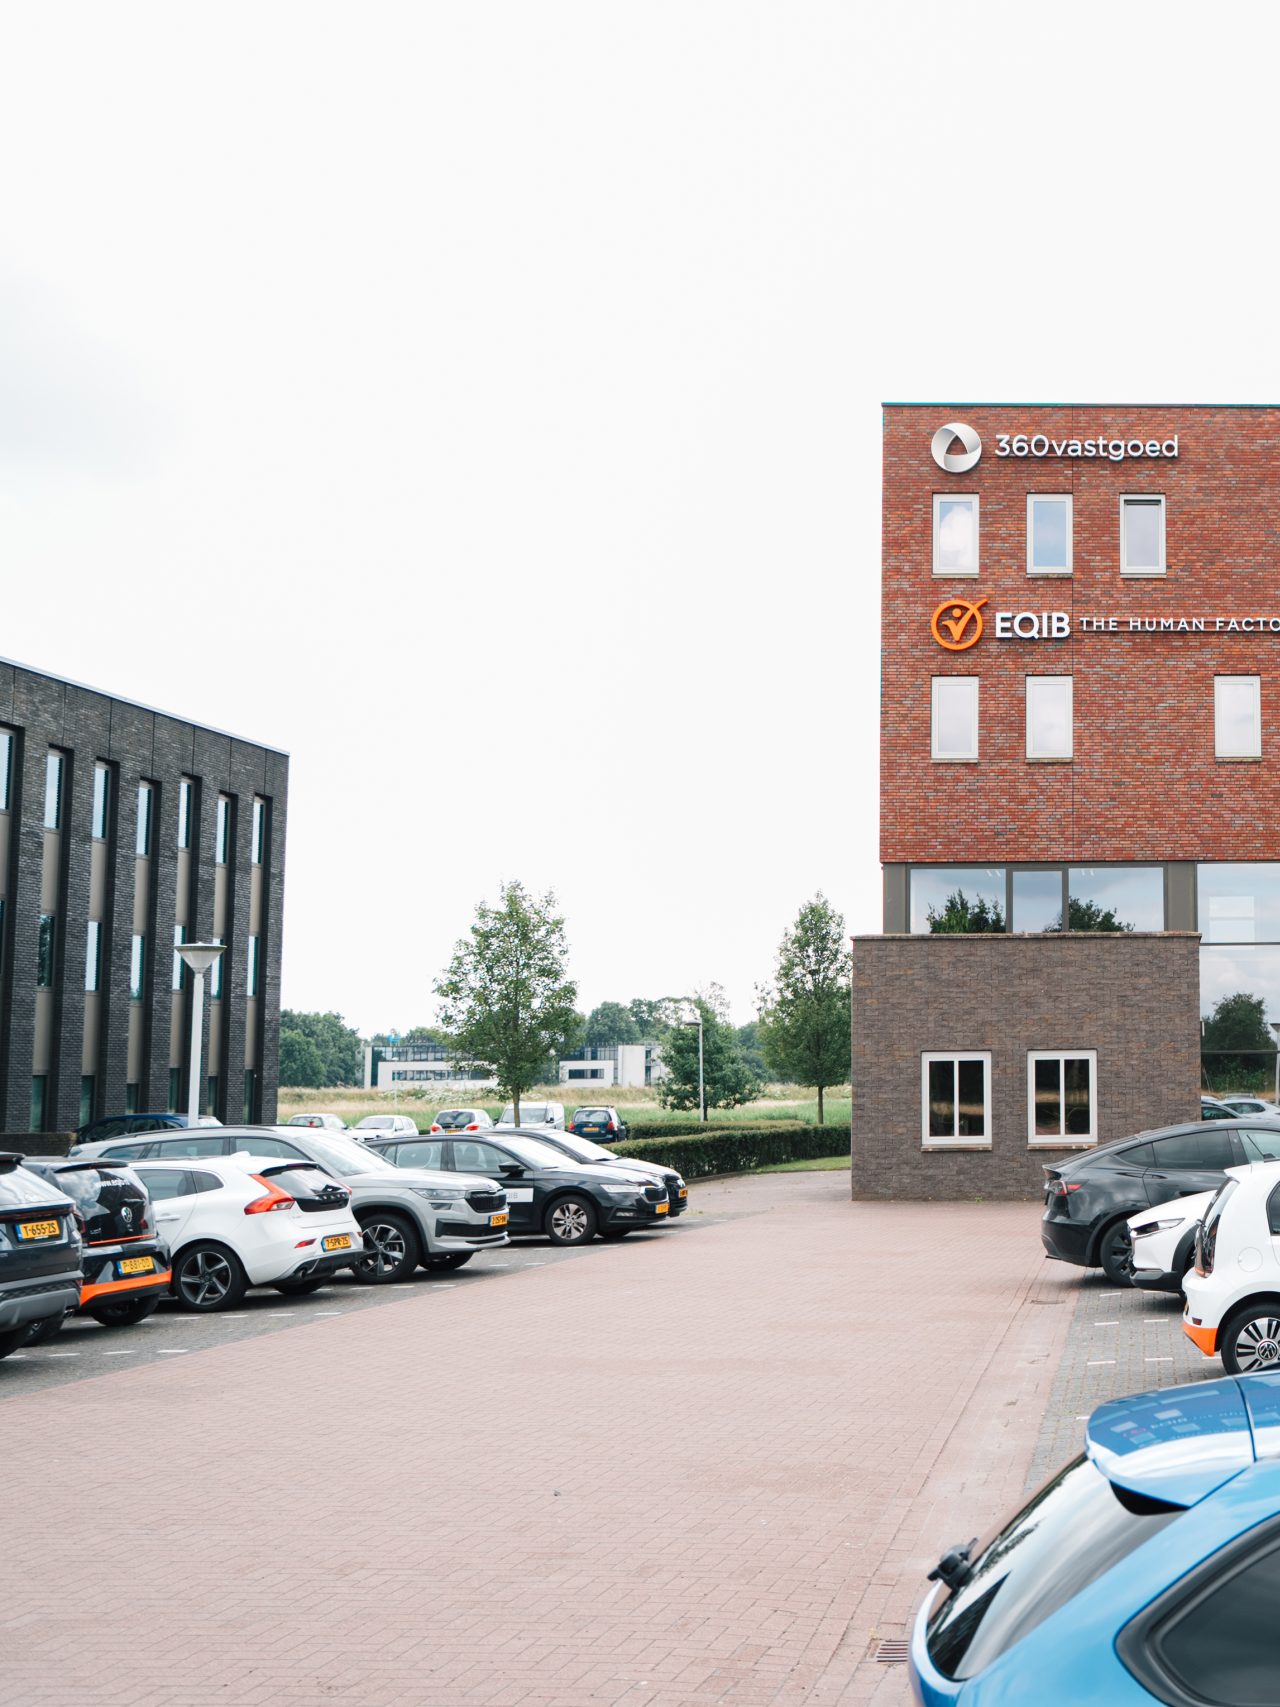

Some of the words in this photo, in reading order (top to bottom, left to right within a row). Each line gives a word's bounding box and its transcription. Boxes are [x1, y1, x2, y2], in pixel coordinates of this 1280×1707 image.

[995, 434, 1178, 461] 360vastgoed
[995, 612, 1070, 640] EQIB
[1079, 617, 1118, 631] THE
[1129, 617, 1204, 631] HUMAN
[23, 1222, 57, 1237] T-655-ZS
